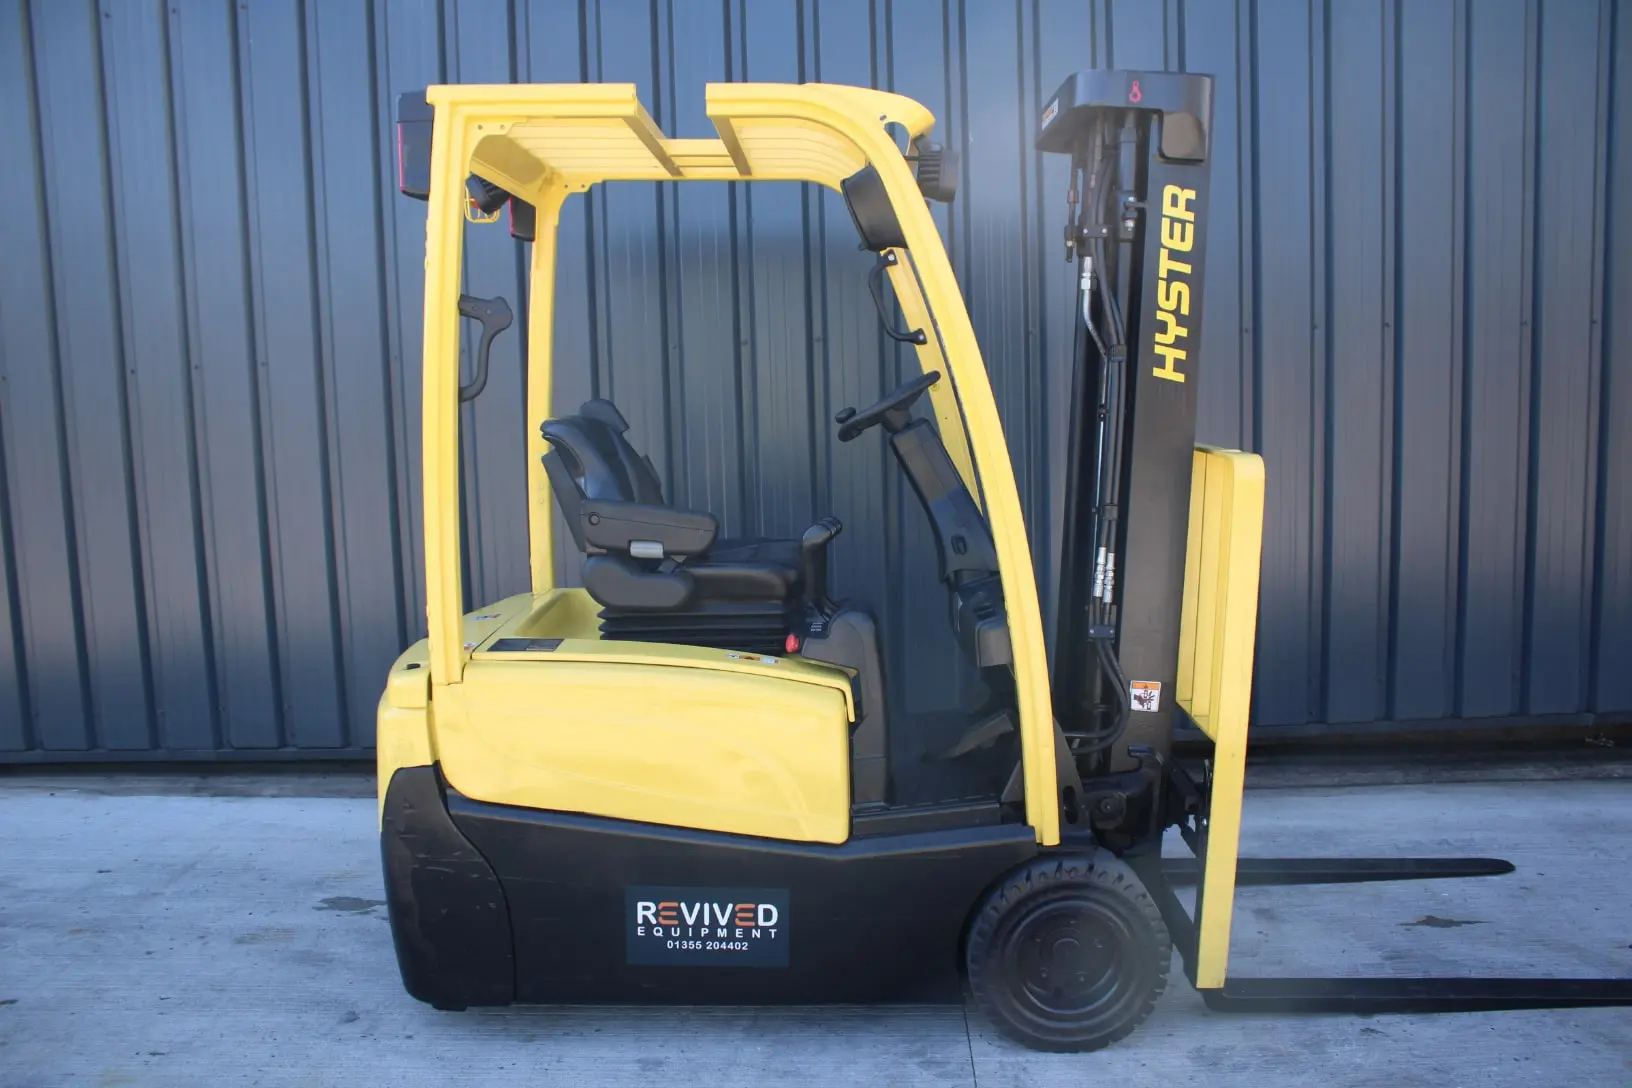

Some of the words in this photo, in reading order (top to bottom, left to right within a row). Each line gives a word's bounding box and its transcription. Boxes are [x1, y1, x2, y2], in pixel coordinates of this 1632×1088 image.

[1152, 184, 1196, 383] HYSTER
[637, 901, 778, 926] REVIVED
[637, 926, 777, 938] EQUIPMENT
[667, 940, 702, 950] 01355
[706, 941, 748, 951] 204402
